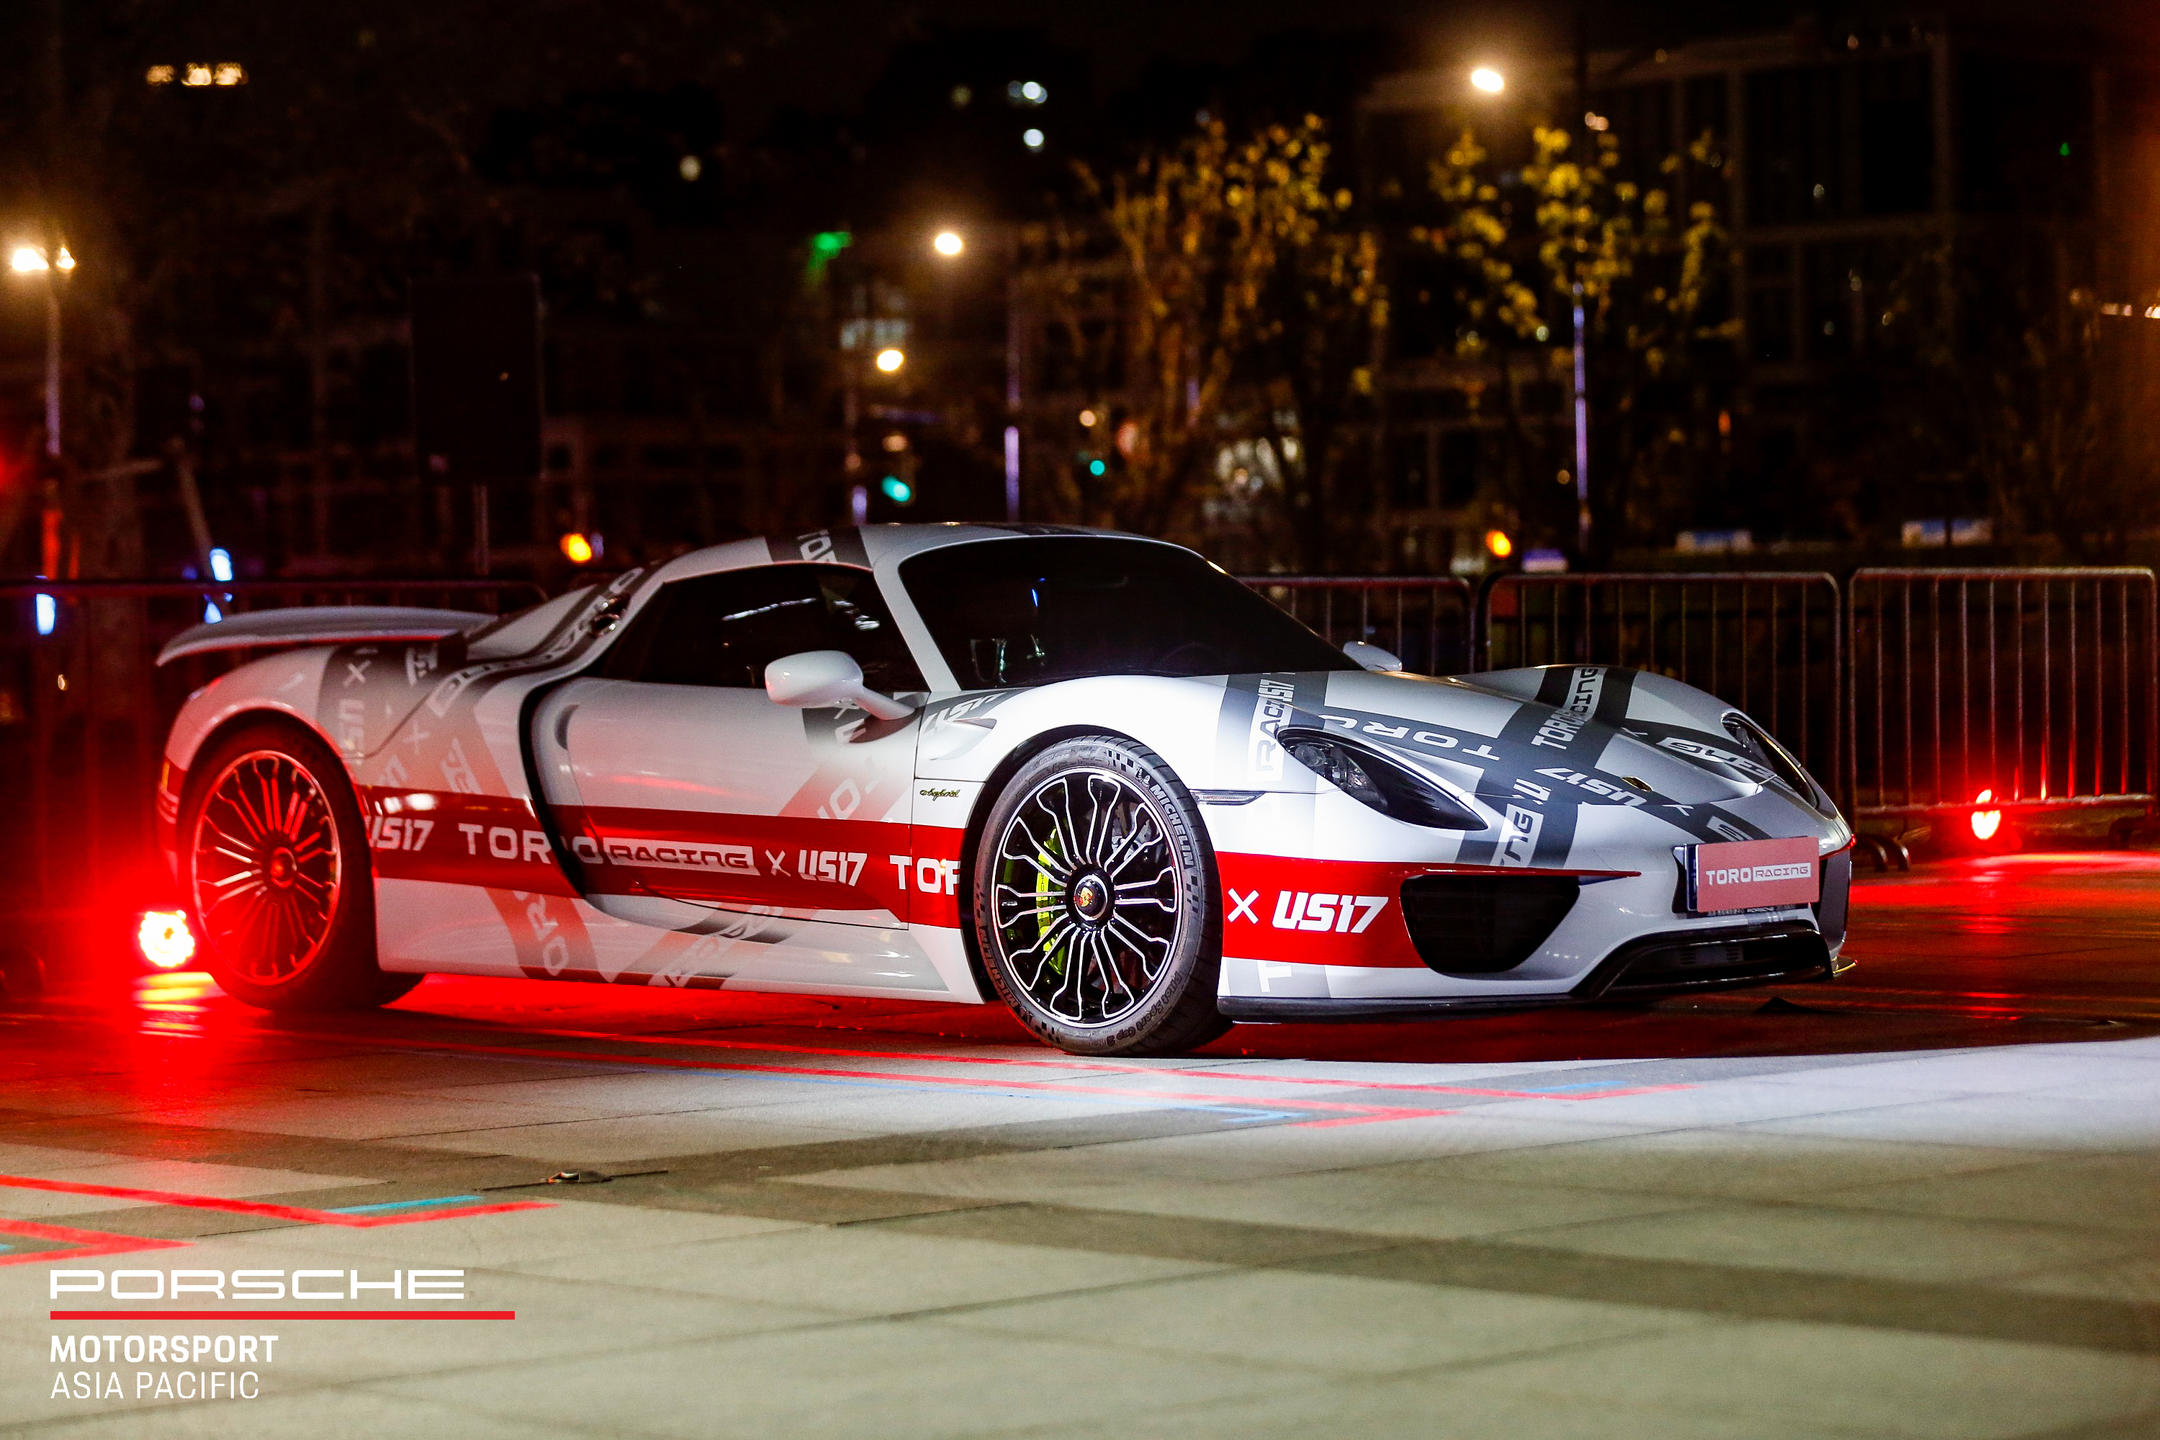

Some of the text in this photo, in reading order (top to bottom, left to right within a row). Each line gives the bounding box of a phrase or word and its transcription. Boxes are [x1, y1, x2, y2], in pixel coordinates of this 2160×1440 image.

[1534, 767, 1648, 806] US17
[1150, 784, 1195, 867] MICHELIN
[607, 842, 751, 871] RACING
[798, 850, 868, 887] US17
[1705, 865, 1809, 886] TORO RACING
[1227, 888, 1389, 934] X US17
